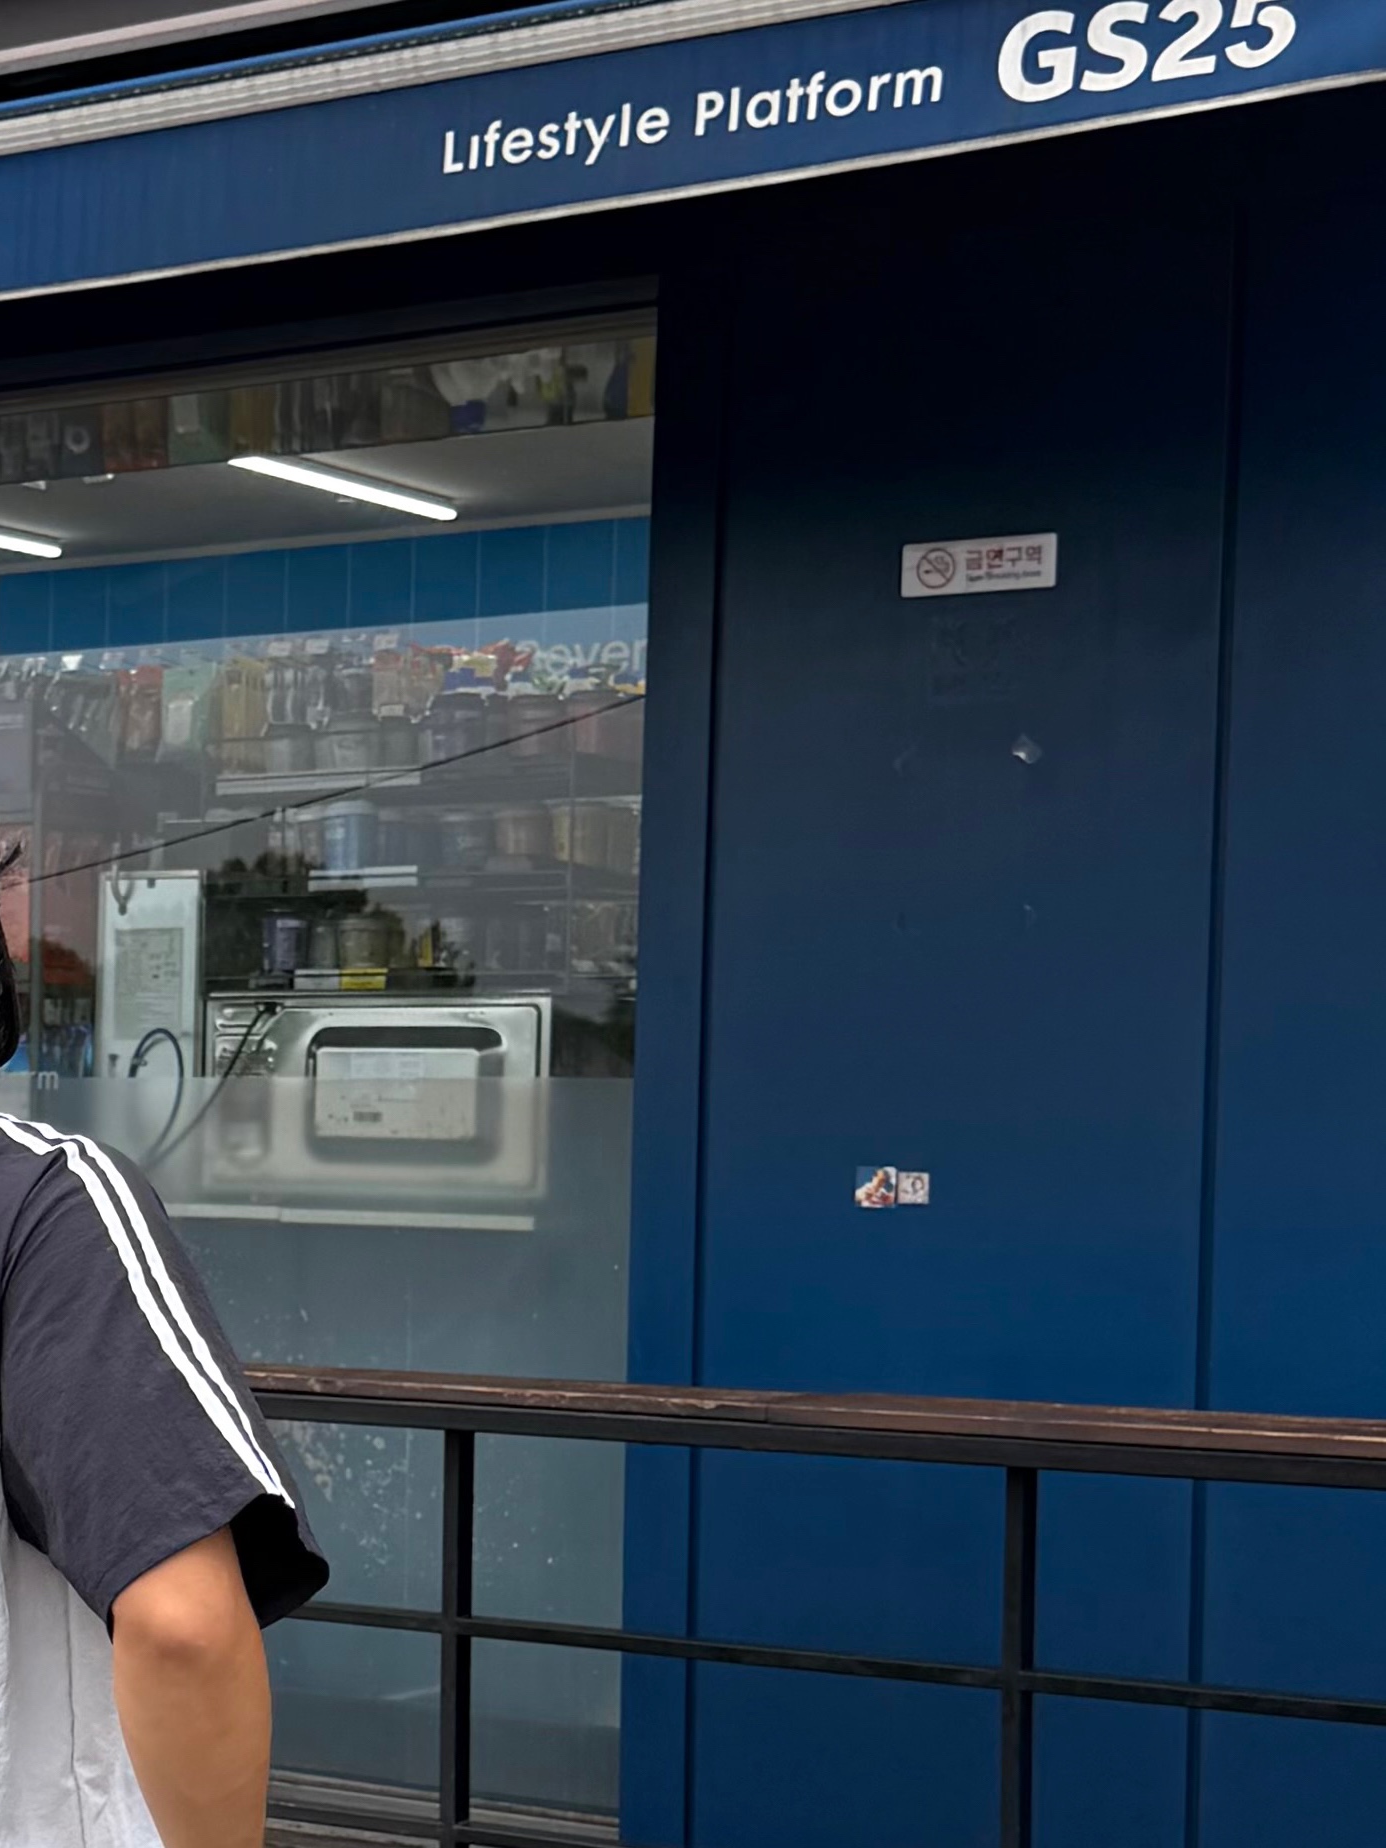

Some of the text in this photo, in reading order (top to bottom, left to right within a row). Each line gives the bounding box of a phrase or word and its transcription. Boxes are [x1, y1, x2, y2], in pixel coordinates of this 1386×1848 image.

[441, 0, 1298, 174] Lifestyle Platform GS25
[965, 545, 1043, 570] 금연구역
